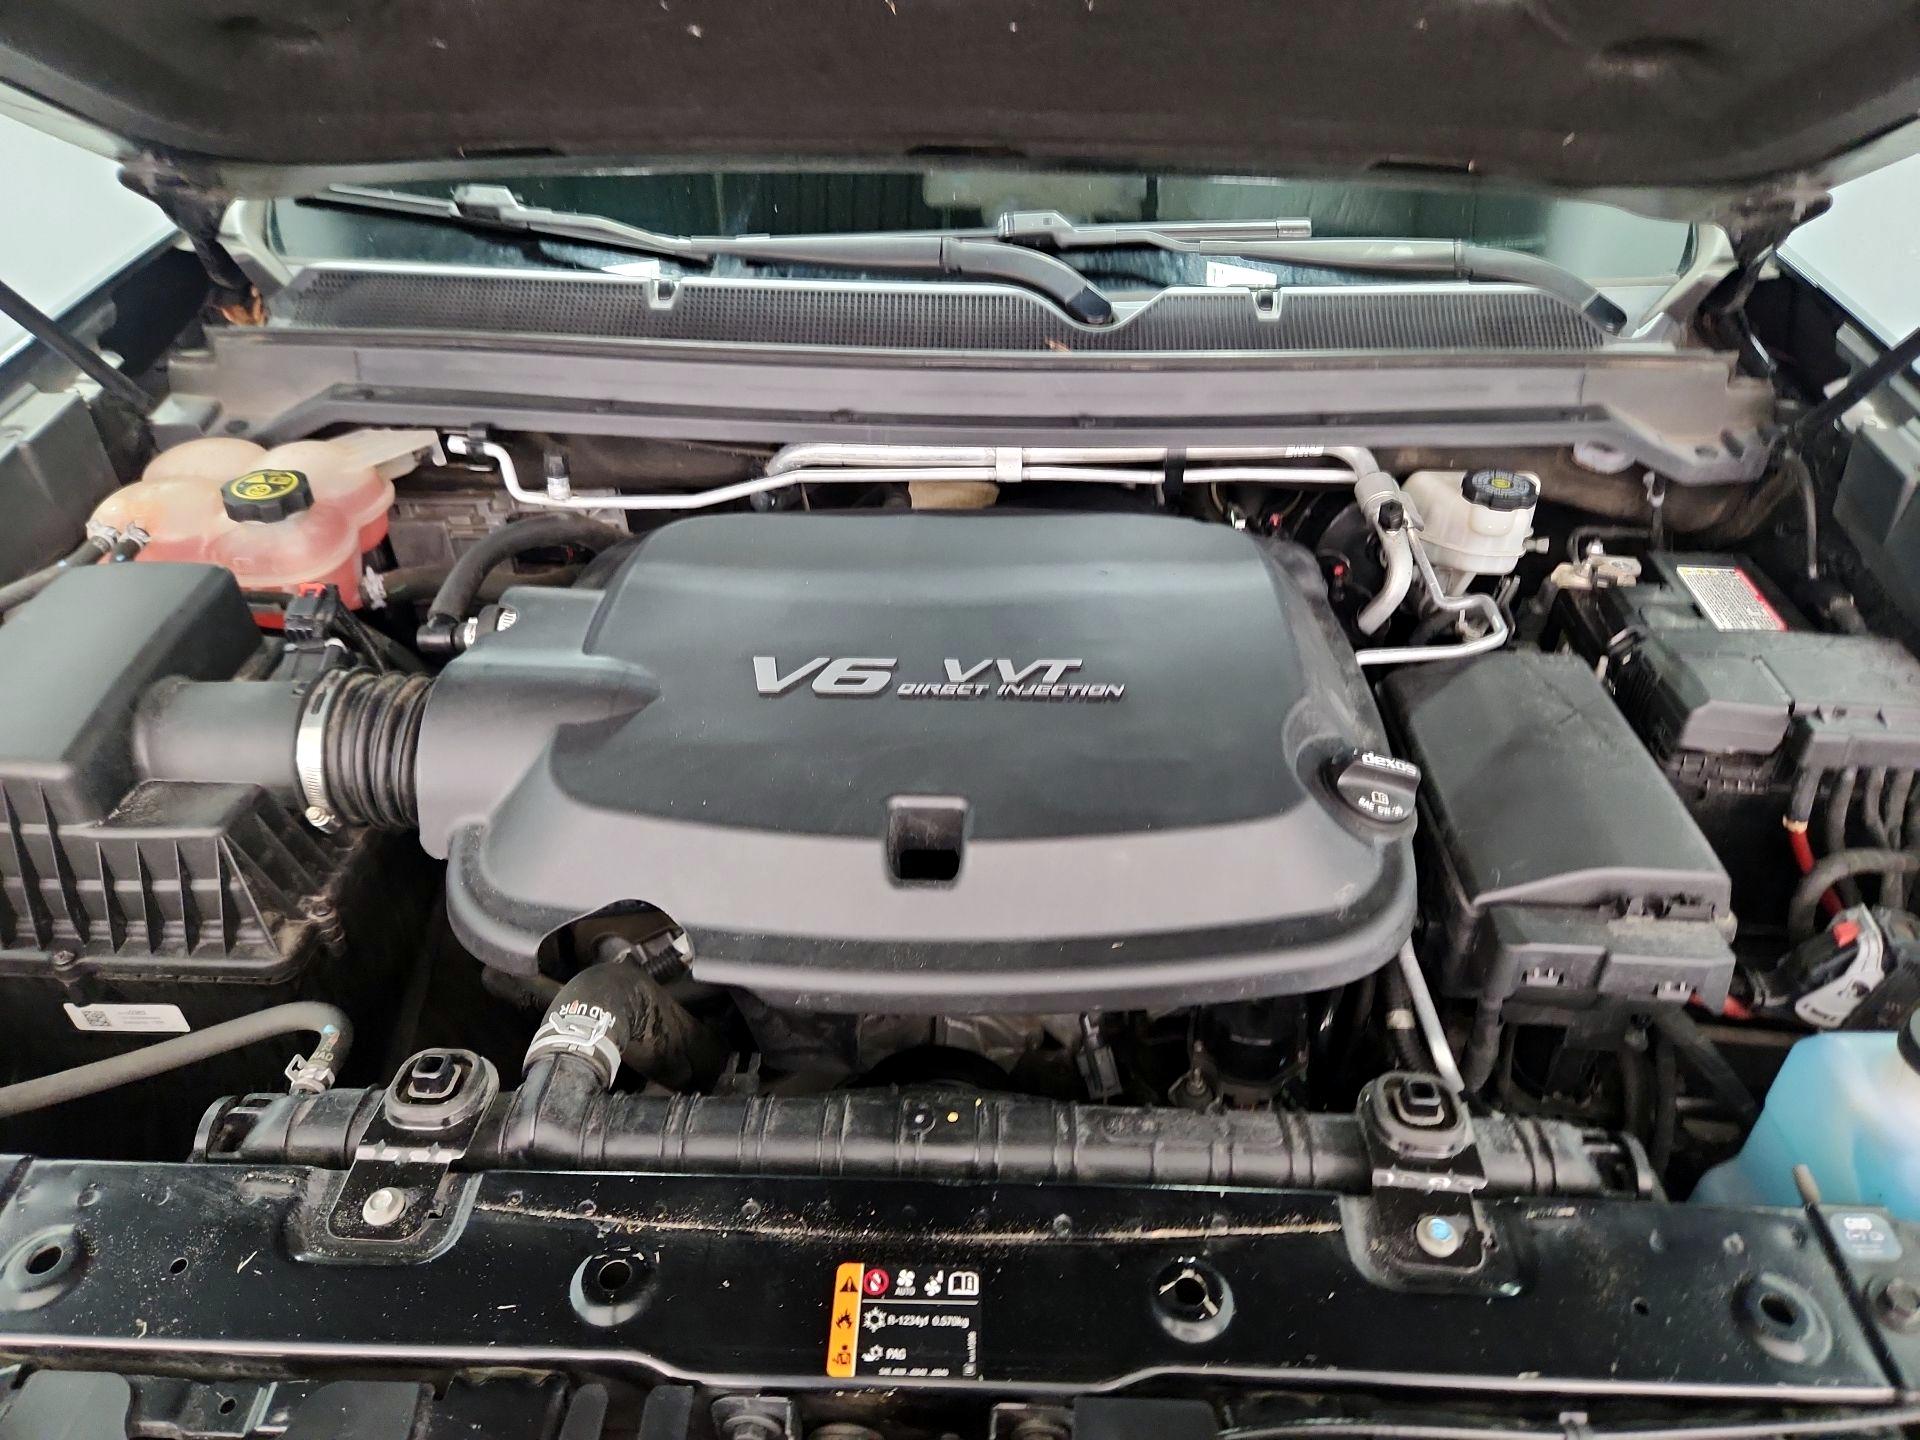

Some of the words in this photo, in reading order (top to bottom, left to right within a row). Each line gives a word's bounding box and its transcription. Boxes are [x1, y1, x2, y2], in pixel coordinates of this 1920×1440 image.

[753, 656, 898, 694] V6
[944, 658, 1083, 684] VVT
[897, 683, 990, 698] DIRECT
[997, 683, 1125, 698] INJECTION
[1361, 751, 1418, 777] dexos
